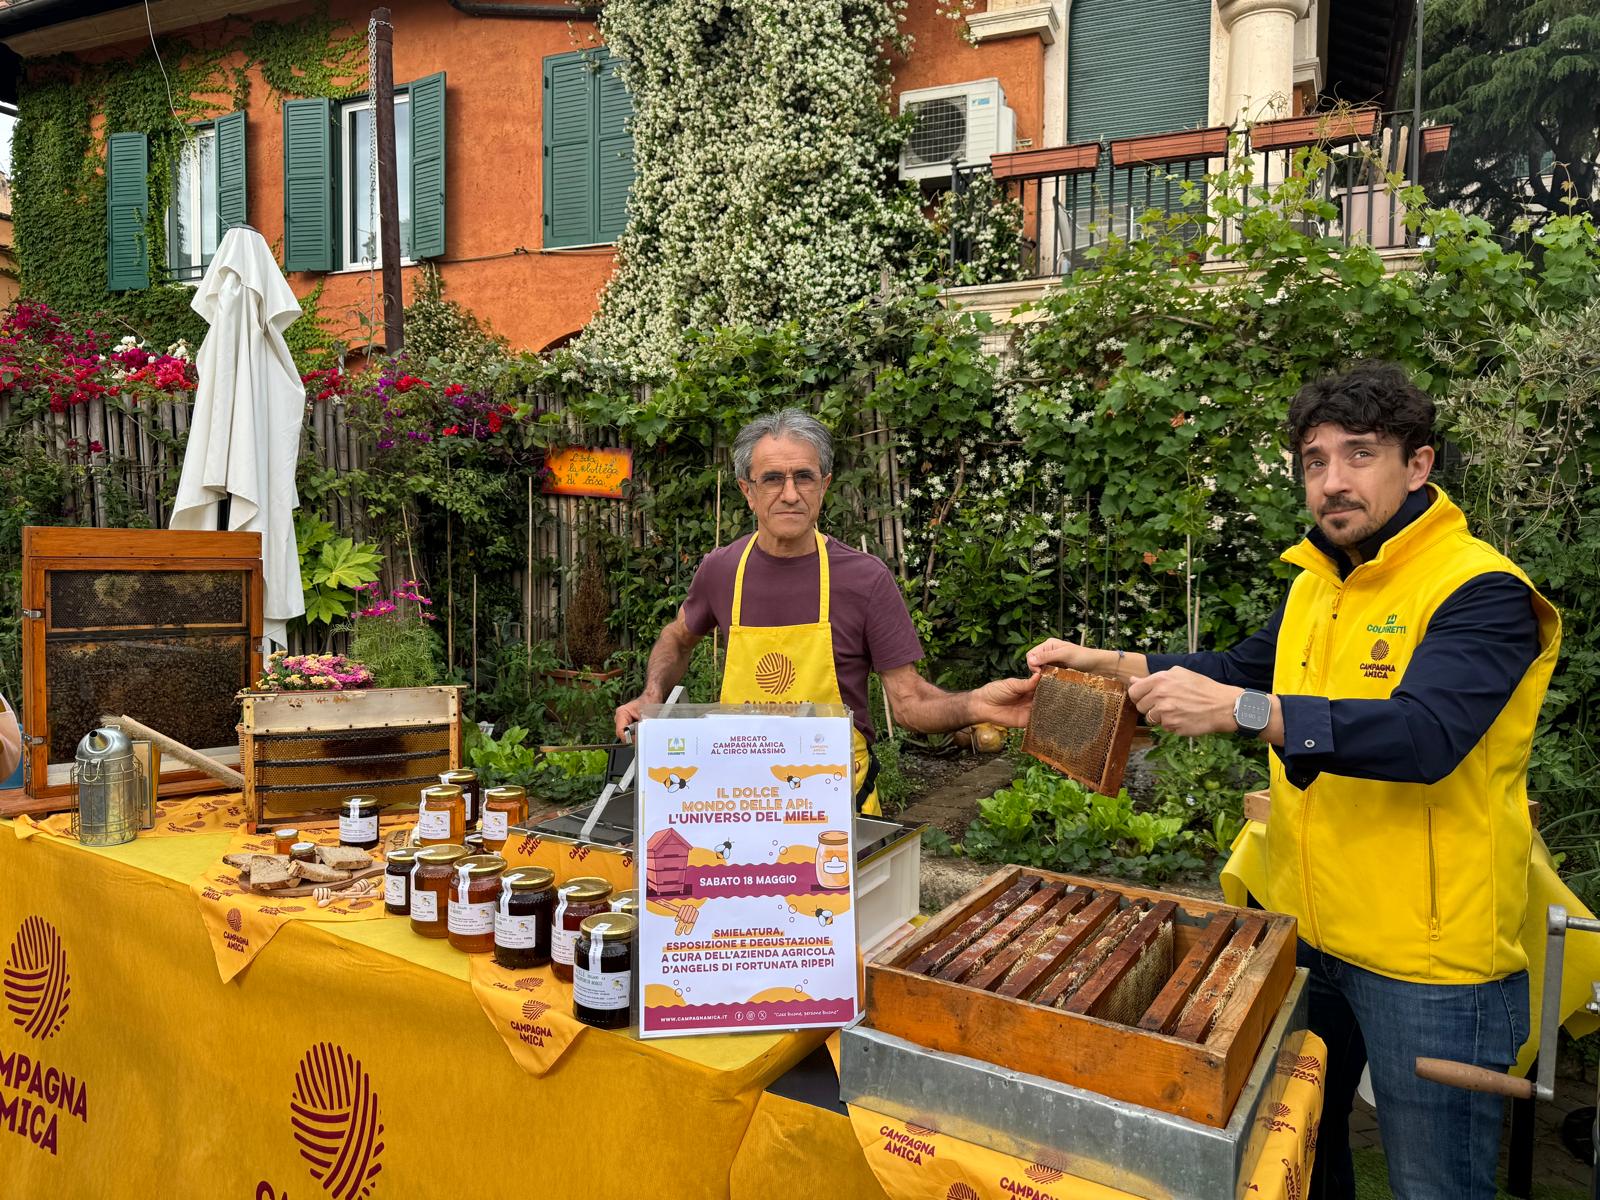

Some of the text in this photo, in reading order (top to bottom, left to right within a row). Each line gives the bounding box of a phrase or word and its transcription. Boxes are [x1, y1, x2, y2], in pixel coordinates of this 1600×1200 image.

[1360, 663, 1396, 672] CAMPAGNA
[1364, 670, 1388, 679] AMICA
[717, 787, 780, 798] IL DOLCE
[682, 799, 813, 812] MONDO DELLE API:
[668, 810, 825, 824] L'UNIVERSO DEL MIELE
[700, 875, 797, 886] SABATO 18 MAGGIO
[223, 931, 249, 946] CAMPAGNA
[714, 928, 784, 937] SMIELATURA,
[227, 941, 245, 953] AMICA
[666, 937, 830, 950] ESPOSIZIONE E DEGUSTAZIONE
[662, 947, 835, 963] A CURA DELL'AZIENDA AGRICOLA
[662, 959, 834, 974] D'ANGELIS DI FORTUNATA RIPEPI
[510, 1021, 552, 1037] CAMPAGNA
[520, 1033, 544, 1047] AMICA
[0, 1051, 87, 1123] MPAGNA
[0, 1091, 57, 1156] MICA
[879, 1125, 935, 1157] CAMPAGNA
[884, 1140, 922, 1166] AMICA
